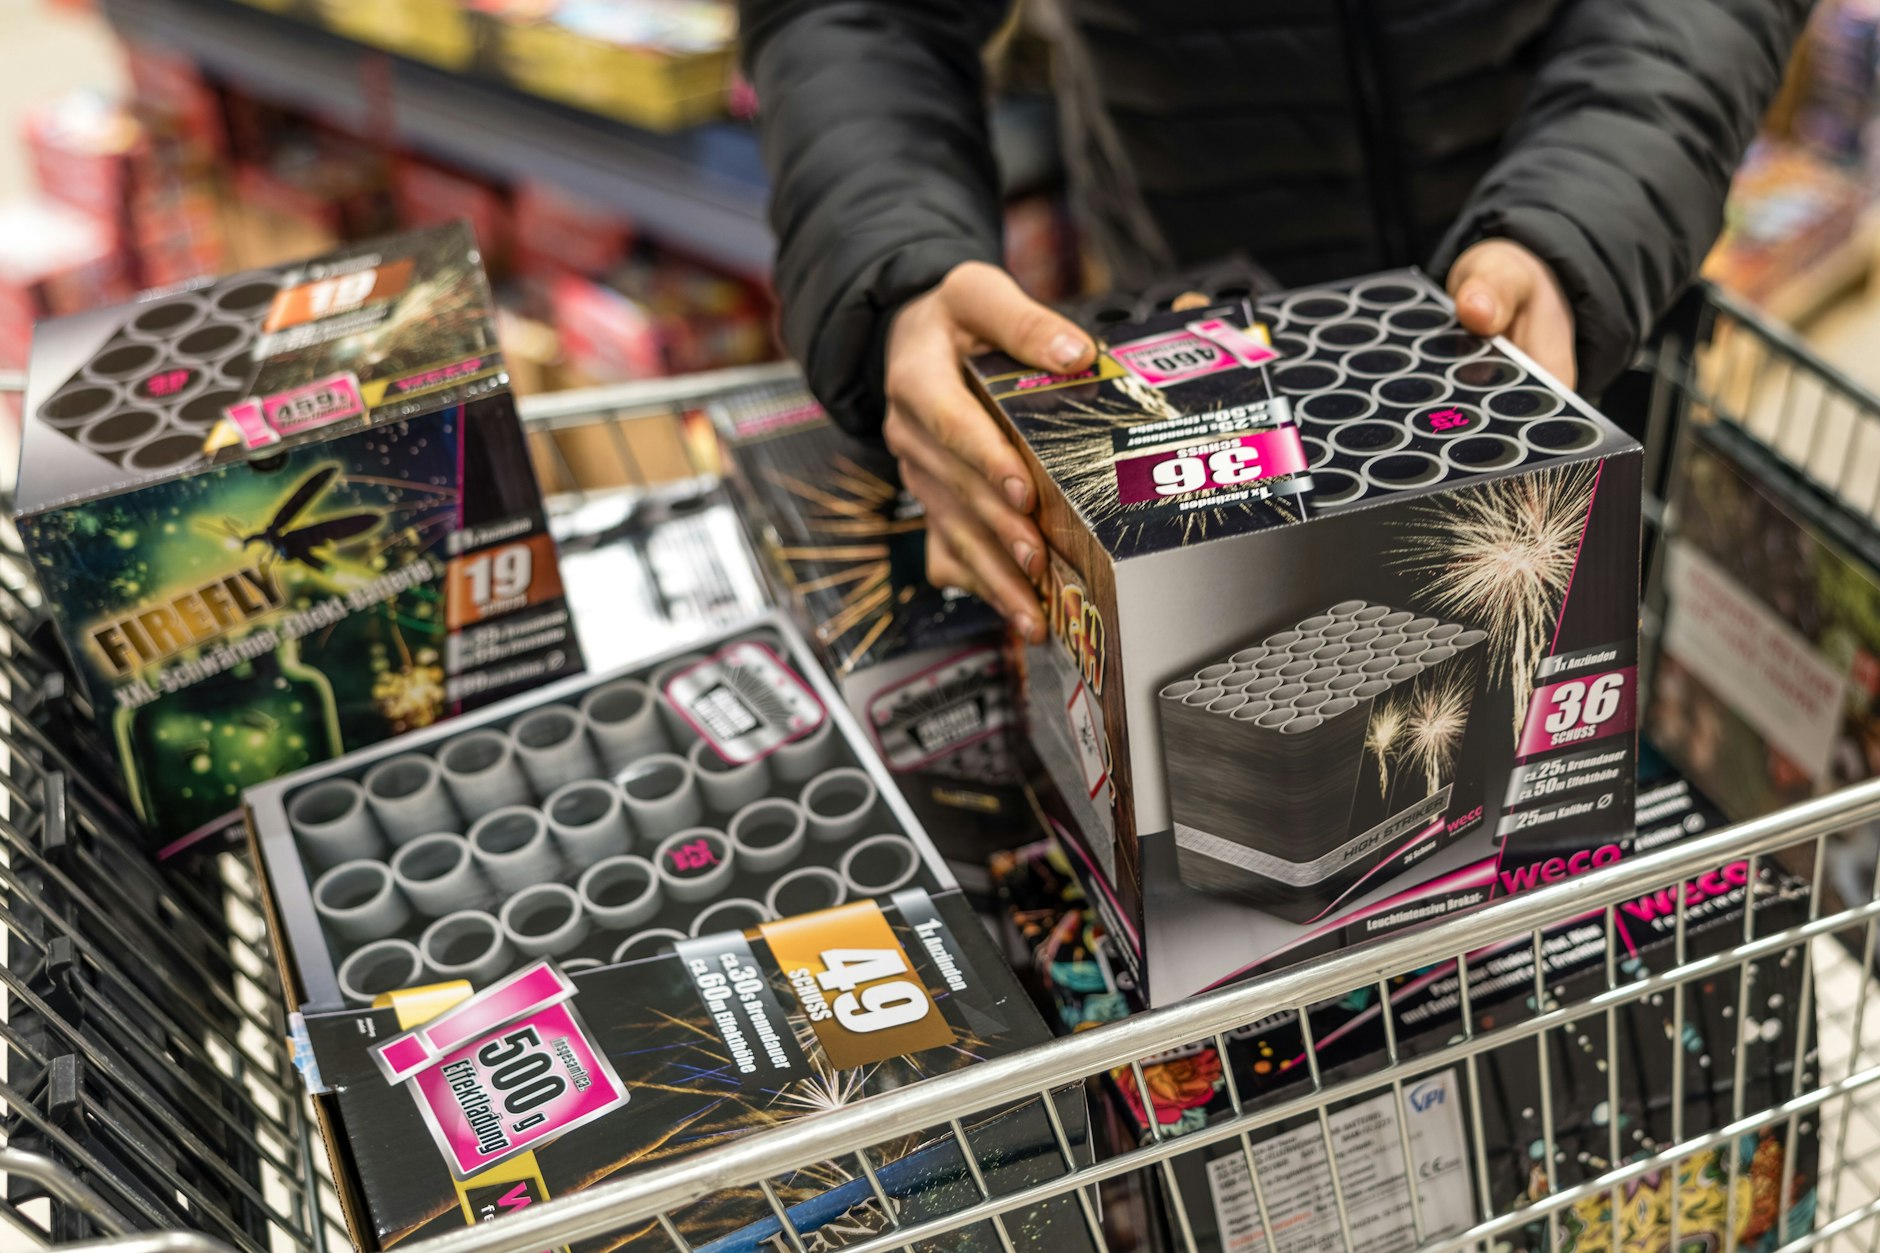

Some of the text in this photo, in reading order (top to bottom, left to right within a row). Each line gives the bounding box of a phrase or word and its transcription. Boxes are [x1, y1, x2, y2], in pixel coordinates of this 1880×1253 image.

[1152, 343, 1219, 372] 460
[1127, 423, 1208, 447] Brenndauer
[1177, 439, 1241, 458] SCHUSS
[1152, 447, 1262, 495] 36
[1180, 492, 1248, 511] Anzünden
[464, 544, 531, 605] 19
[91, 565, 288, 677] FIREFLY
[1567, 650, 1617, 671] Anzünden
[1545, 673, 1624, 733] 36
[1550, 724, 1596, 746] SCHUSS
[1566, 768, 1619, 789] Effekthöhe
[1567, 750, 1626, 772] Brenndauer
[1343, 796, 1444, 861] HIGH STRIKER
[1447, 805, 1483, 832] weco
[1516, 801, 1594, 829] 25mm Kaliber
[1366, 892, 1483, 932] Leuchtintensive Brokat-
[915, 918, 968, 992] 1x Anzünden
[788, 967, 833, 1022] SCHUSS
[815, 948, 930, 1034] 49
[714, 1011, 756, 1075] Effekthöhe
[743, 999, 791, 1069] Brenndauer
[477, 1024, 568, 1114] 500
[440, 1057, 513, 1156] Effektladung
[512, 1111, 548, 1134] g
